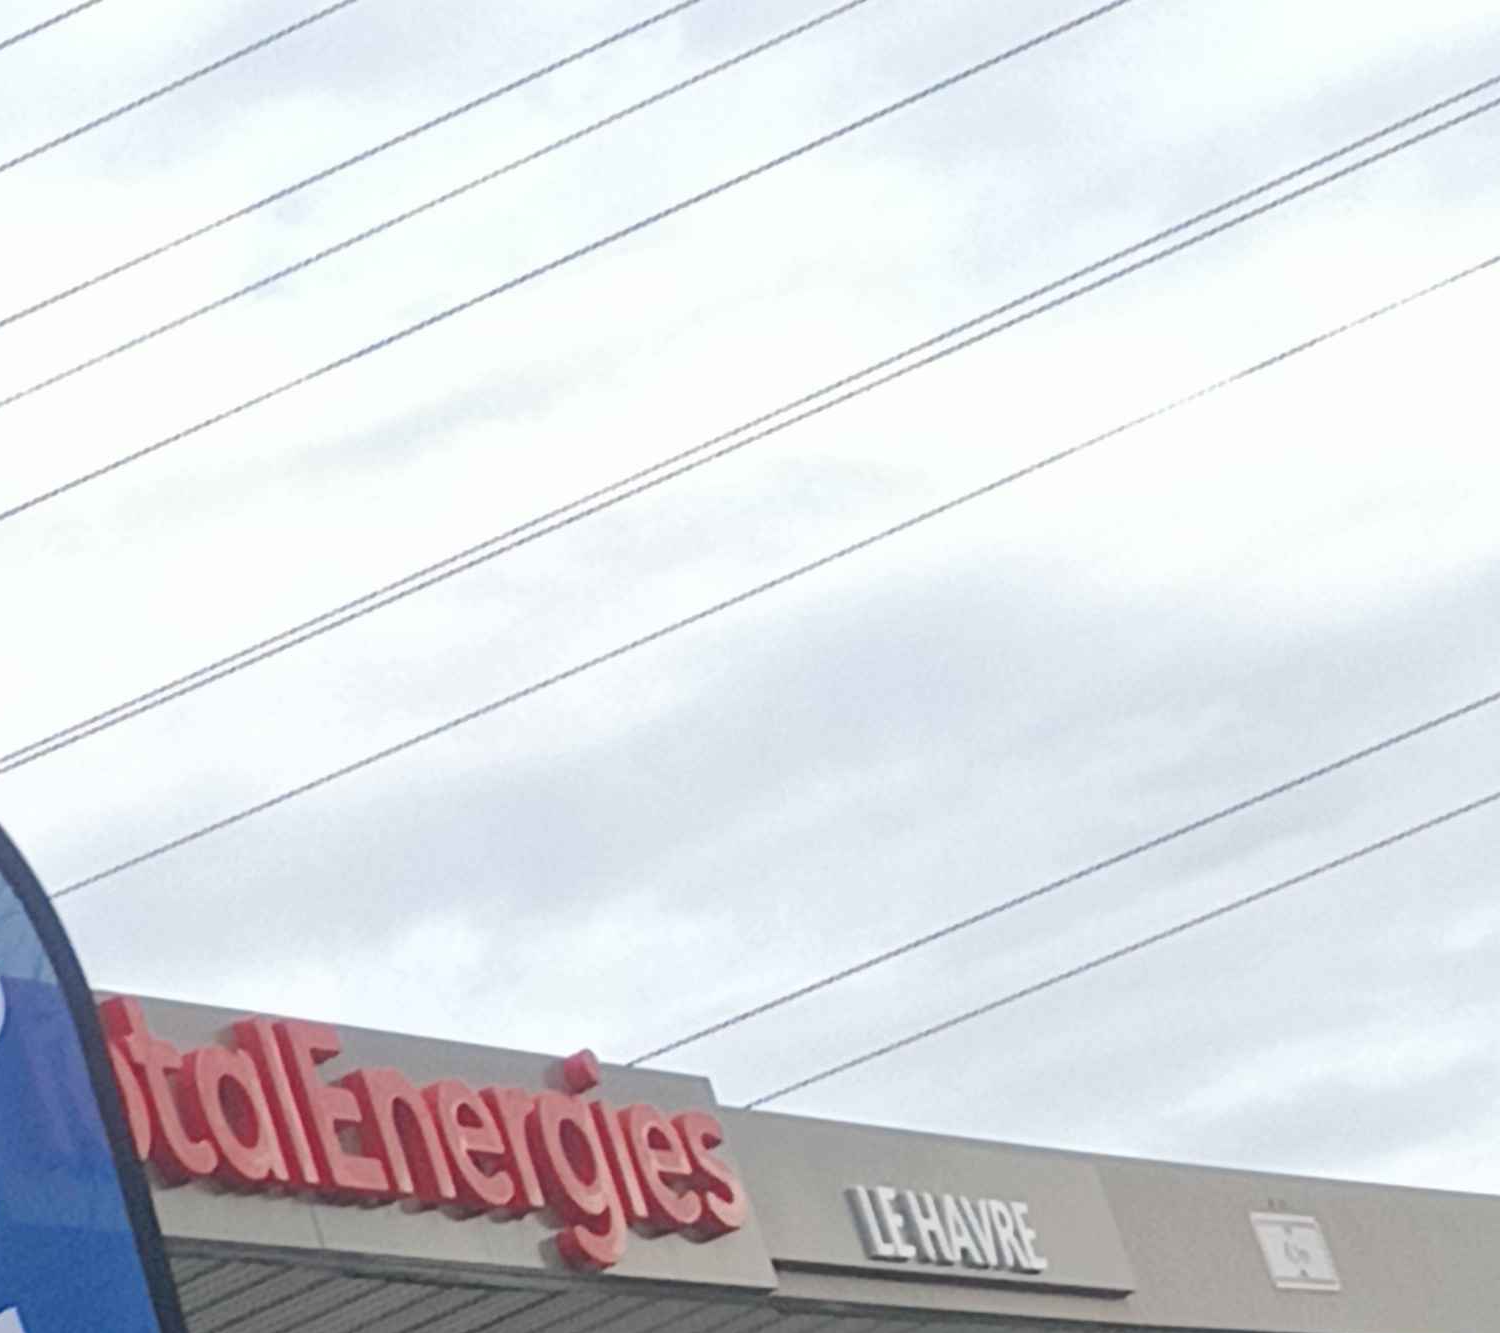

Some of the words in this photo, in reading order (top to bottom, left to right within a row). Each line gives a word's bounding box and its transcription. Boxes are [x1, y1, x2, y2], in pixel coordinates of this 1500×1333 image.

[102, 995, 750, 1271] talEnergies
[845, 1185, 916, 1261] LE
[900, 1189, 1048, 1274] HAVRE
